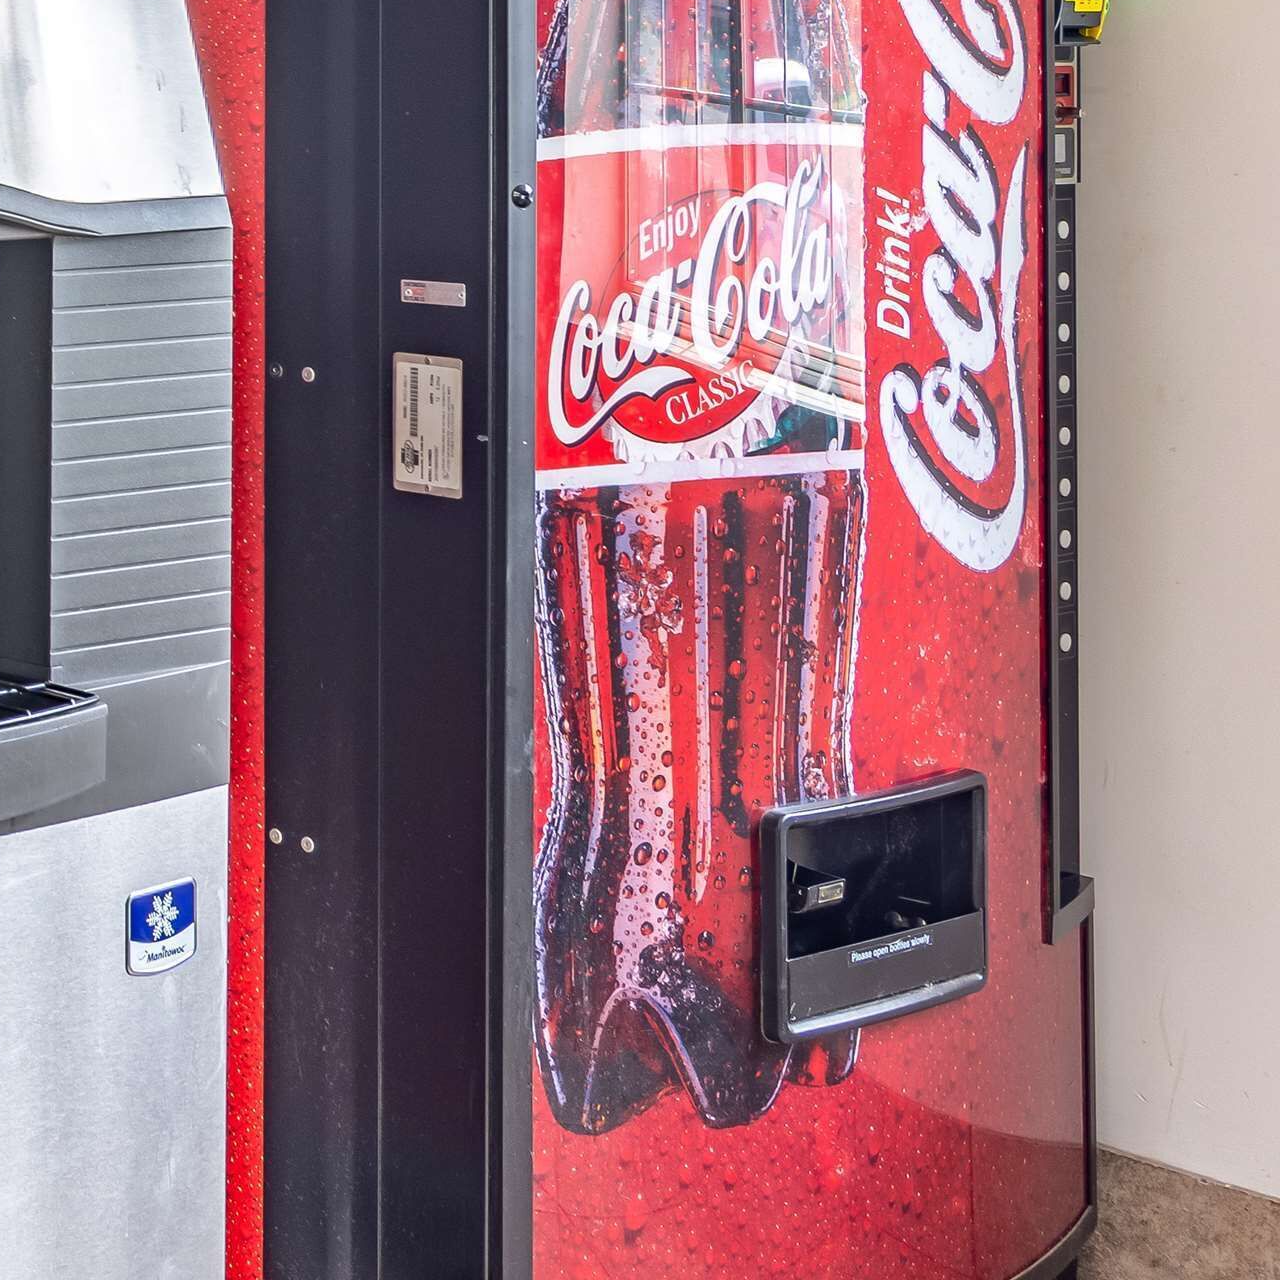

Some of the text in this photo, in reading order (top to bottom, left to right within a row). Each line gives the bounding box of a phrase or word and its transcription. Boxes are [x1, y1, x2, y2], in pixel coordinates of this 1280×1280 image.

[638, 196, 702, 261] Enjoy
[876, 186, 911, 340] Drink!
[547, 152, 838, 448] Coca-Cola
[664, 358, 758, 427] CLASSIC
[851, 948, 873, 963] Please
[873, 945, 890, 959] open
